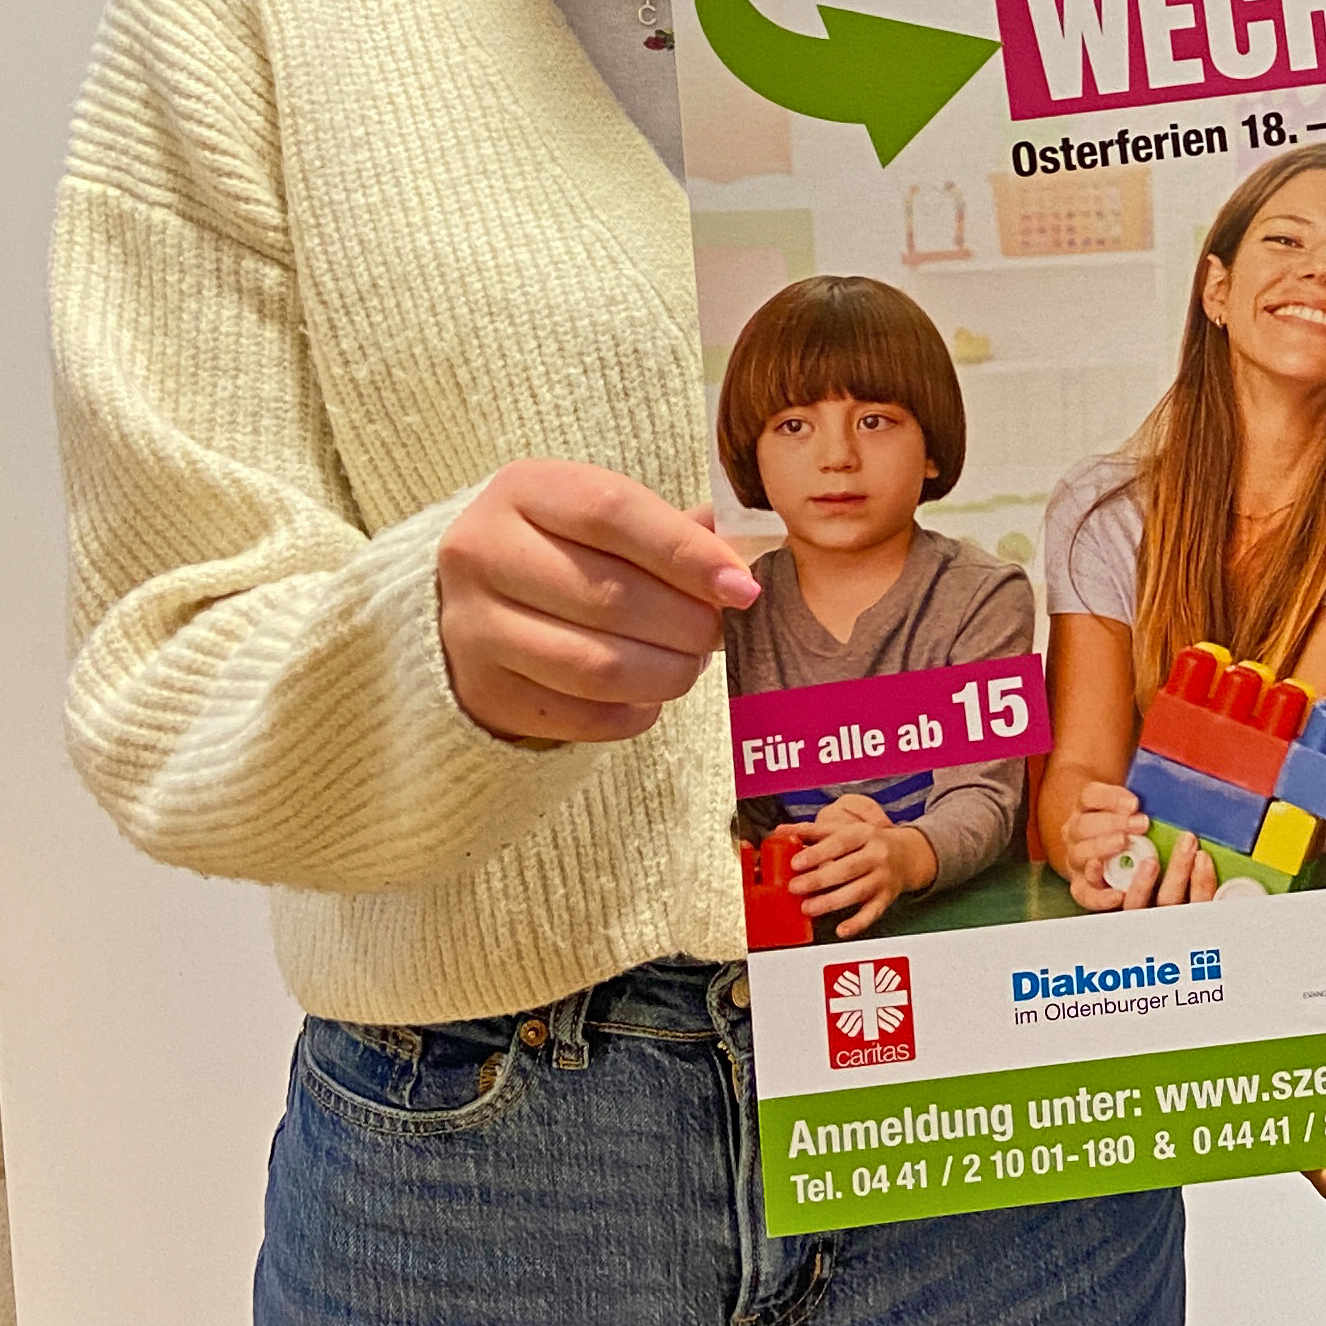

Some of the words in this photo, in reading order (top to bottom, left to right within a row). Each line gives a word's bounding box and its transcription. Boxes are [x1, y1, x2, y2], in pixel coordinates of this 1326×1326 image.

[1011, 122, 1228, 178] Osterferien
[1241, 111, 1298, 150] 18.
[742, 734, 804, 775] Für
[818, 724, 886, 764] alle
[898, 714, 943, 752] ab
[951, 676, 1029, 742] 15
[1012, 957, 1180, 1002] Diakonie
[1014, 1006, 1038, 1025] im
[1045, 991, 1168, 1022] Oldenburger
[1175, 984, 1224, 1007] Land
[835, 1042, 910, 1068] caritas
[788, 1102, 1014, 1158] Anmeldung
[1028, 1087, 1142, 1130] unter:
[790, 1172, 842, 1204] Tel.
[1153, 1132, 1176, 1160] &
